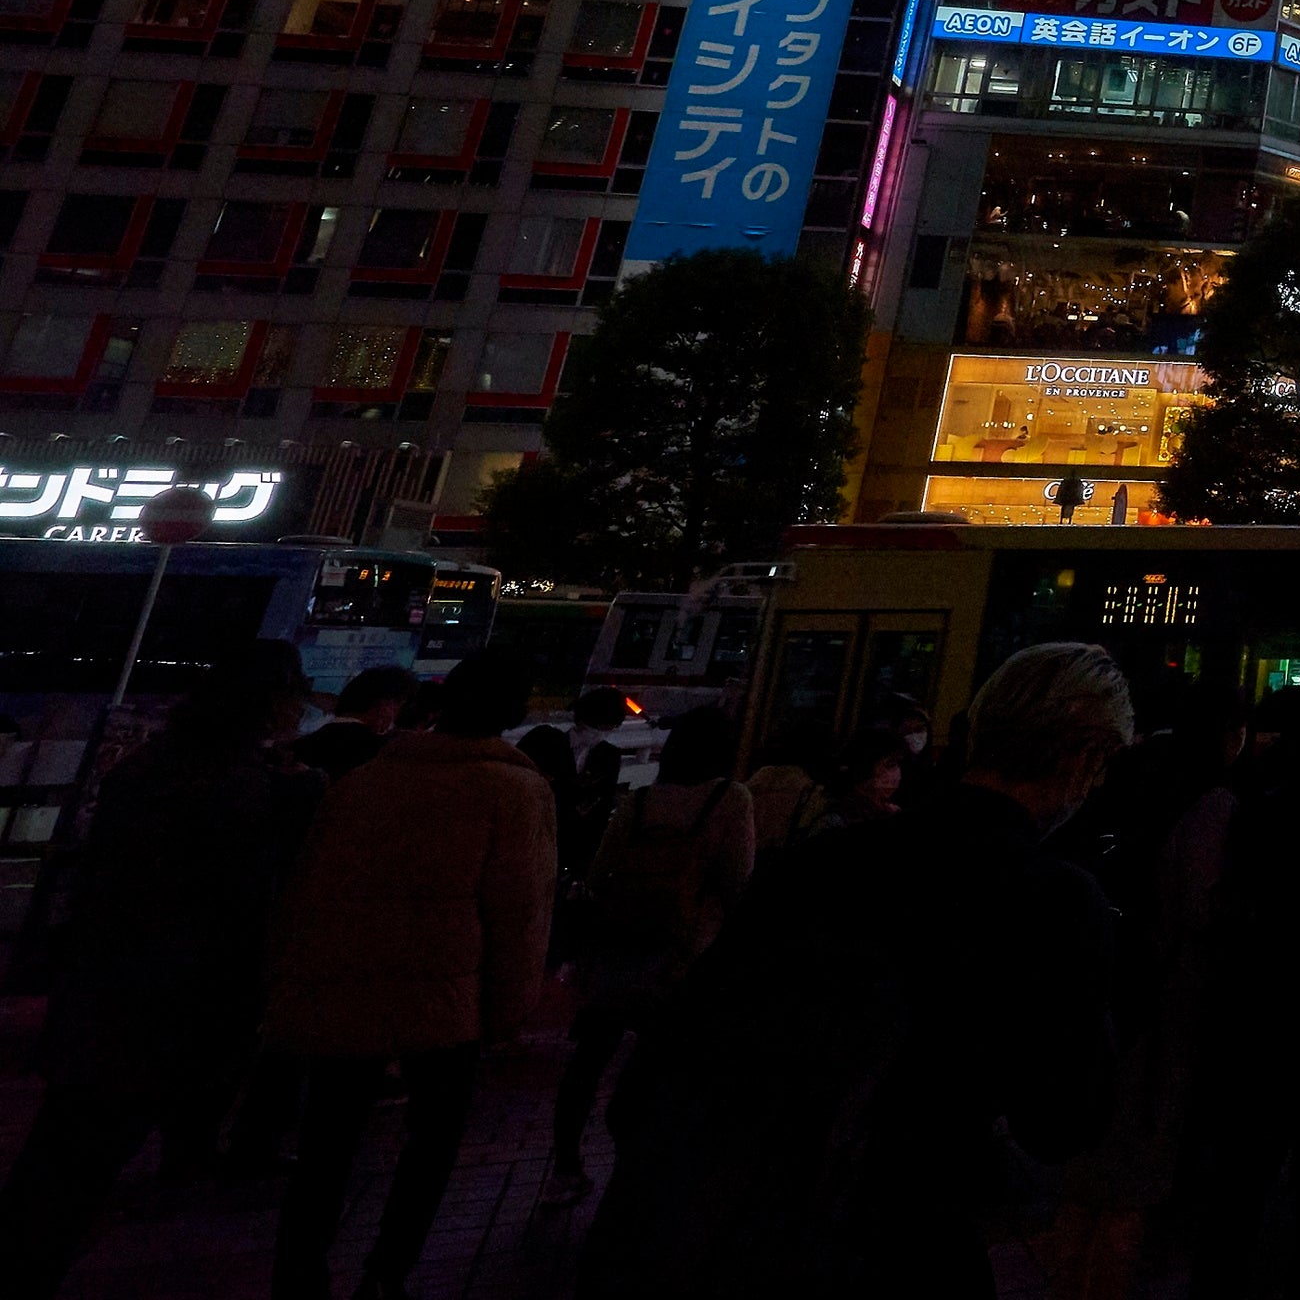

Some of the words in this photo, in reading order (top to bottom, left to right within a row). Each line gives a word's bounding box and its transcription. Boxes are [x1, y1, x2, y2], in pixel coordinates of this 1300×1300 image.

[948, 13, 1010, 34] AEON
[1031, 17, 1219, 52] 英会話イーオン
[1232, 35, 1260, 54] 6F
[1046, 387, 1061, 397] EN
[1066, 387, 1125, 399] PROVENCE
[0, 466, 282, 522] ンドラグ
[1044, 480, 1095, 500] Cé
